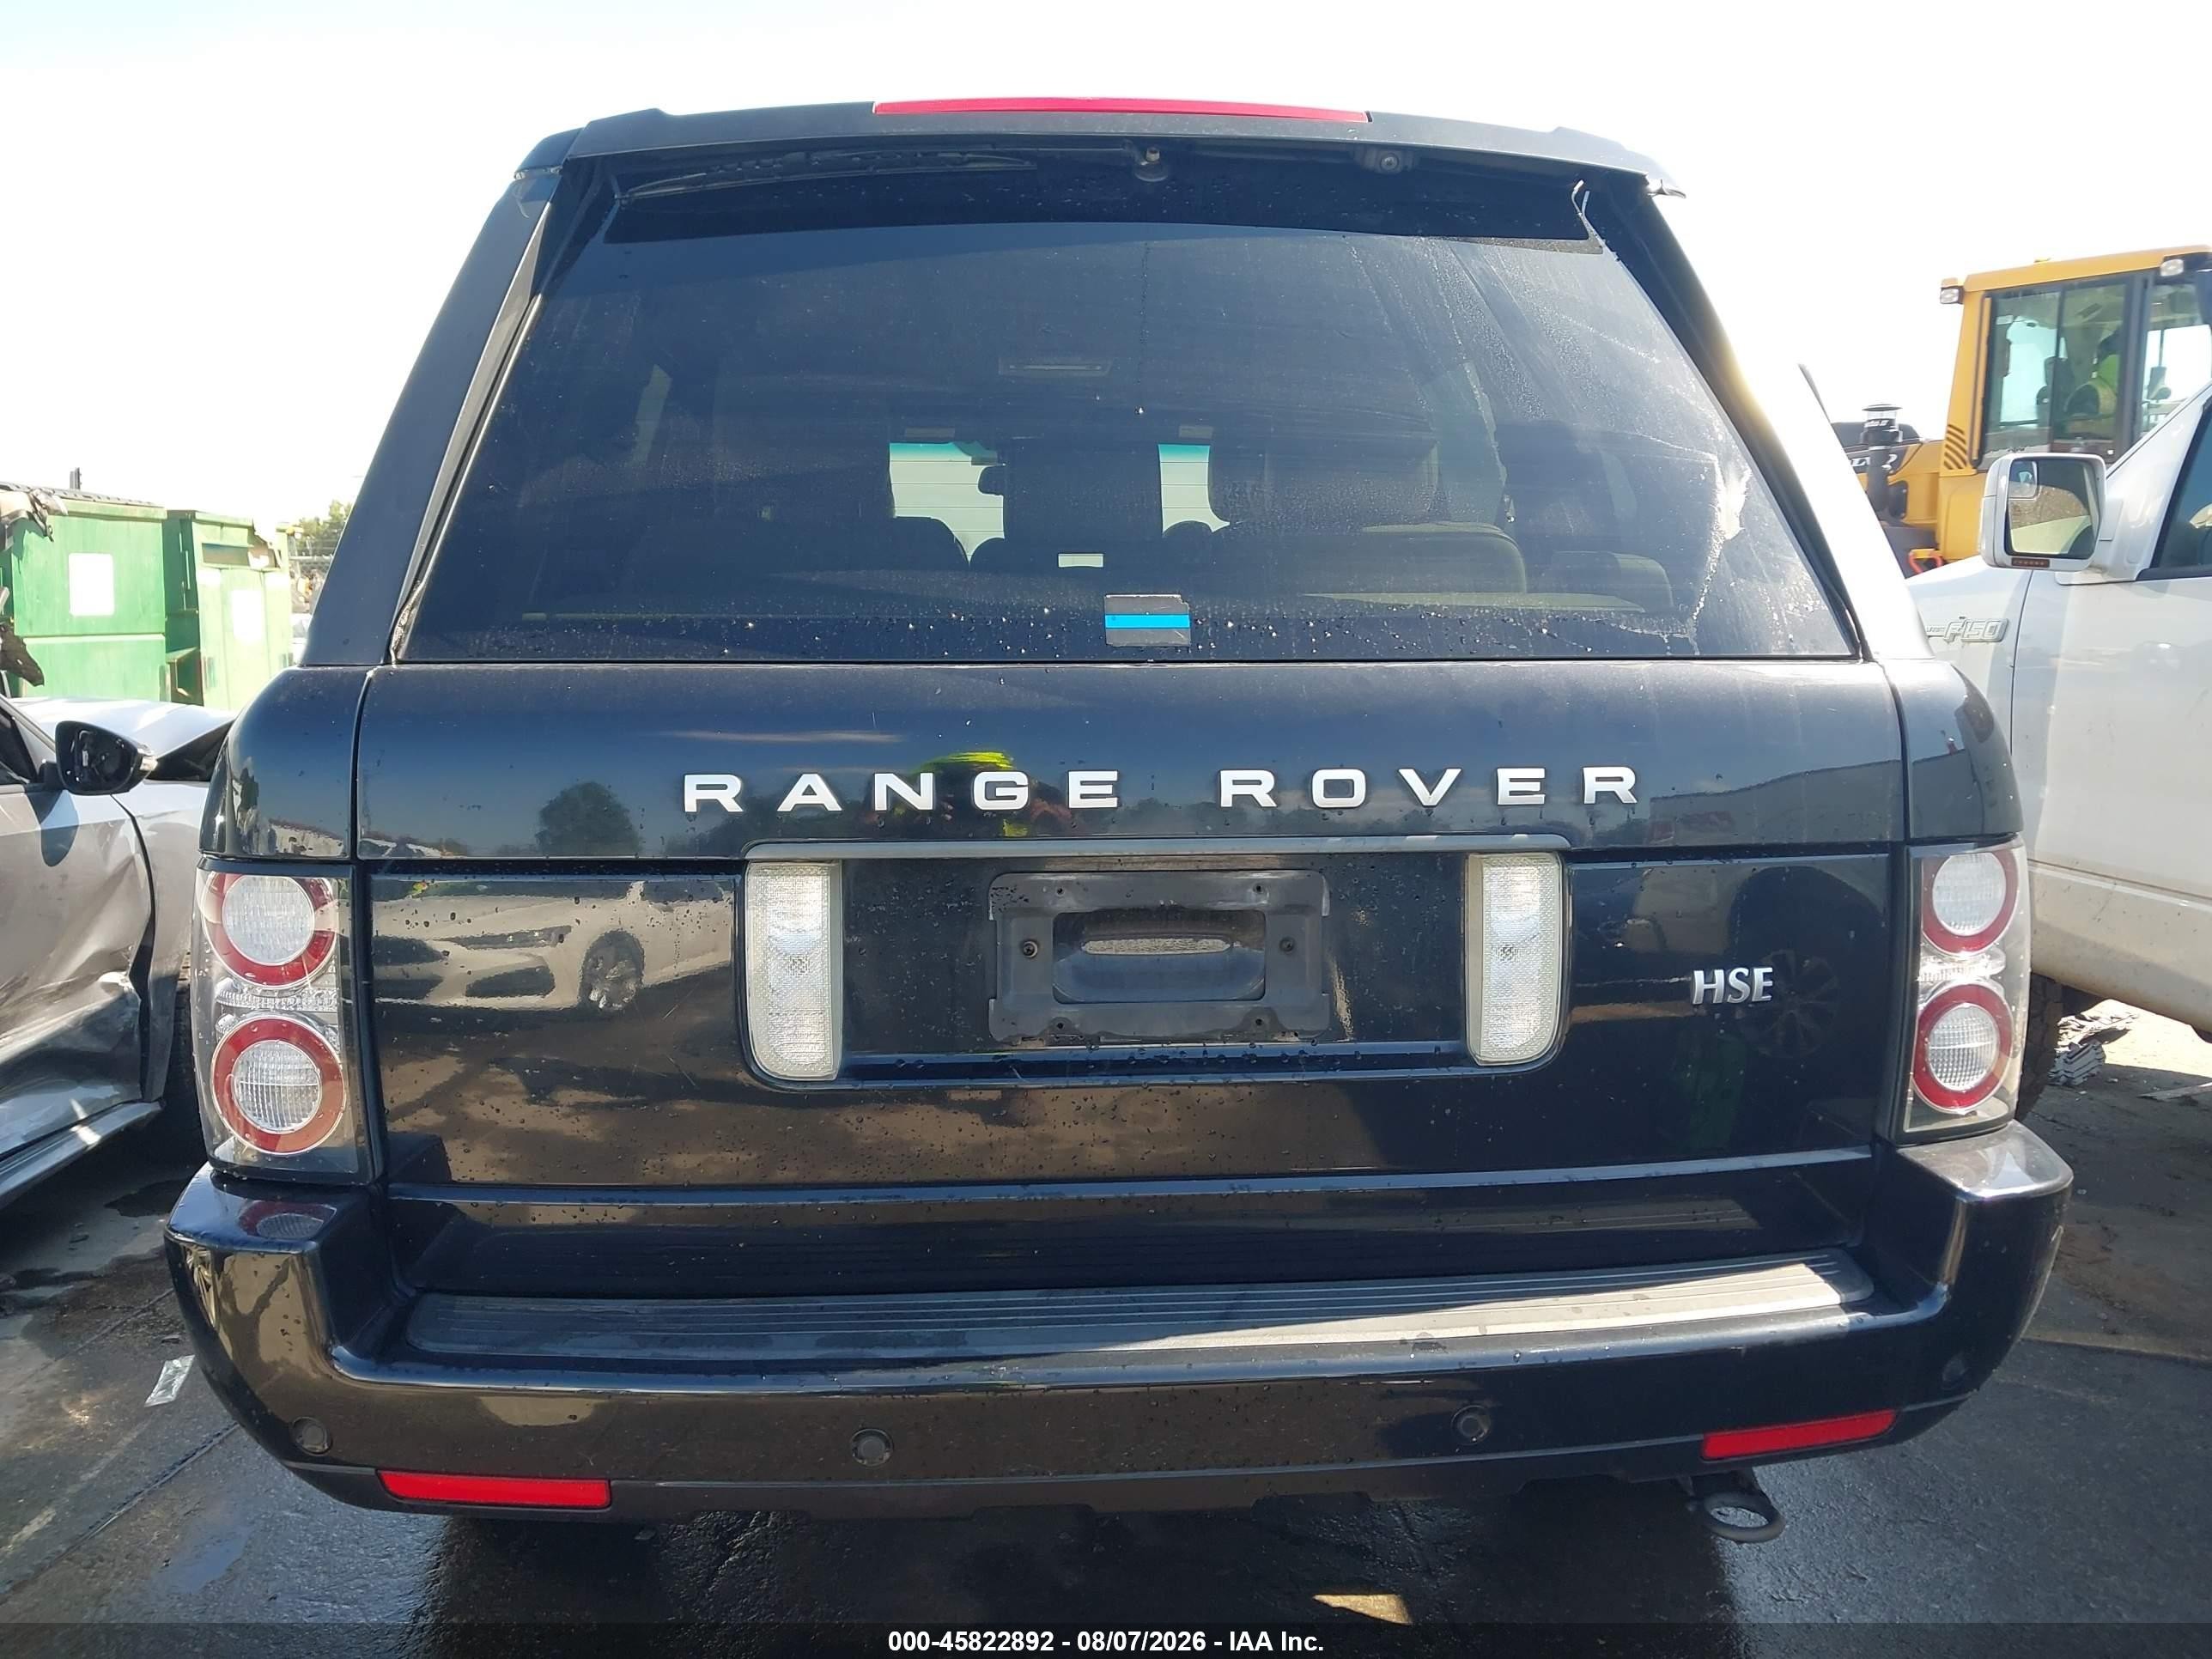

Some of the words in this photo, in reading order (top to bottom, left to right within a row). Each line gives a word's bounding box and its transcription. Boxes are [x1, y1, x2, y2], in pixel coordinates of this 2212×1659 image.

[684, 770, 1118, 811] RANGE
[1219, 767, 1638, 808] ROVER
[1692, 967, 1773, 1005] HSE
